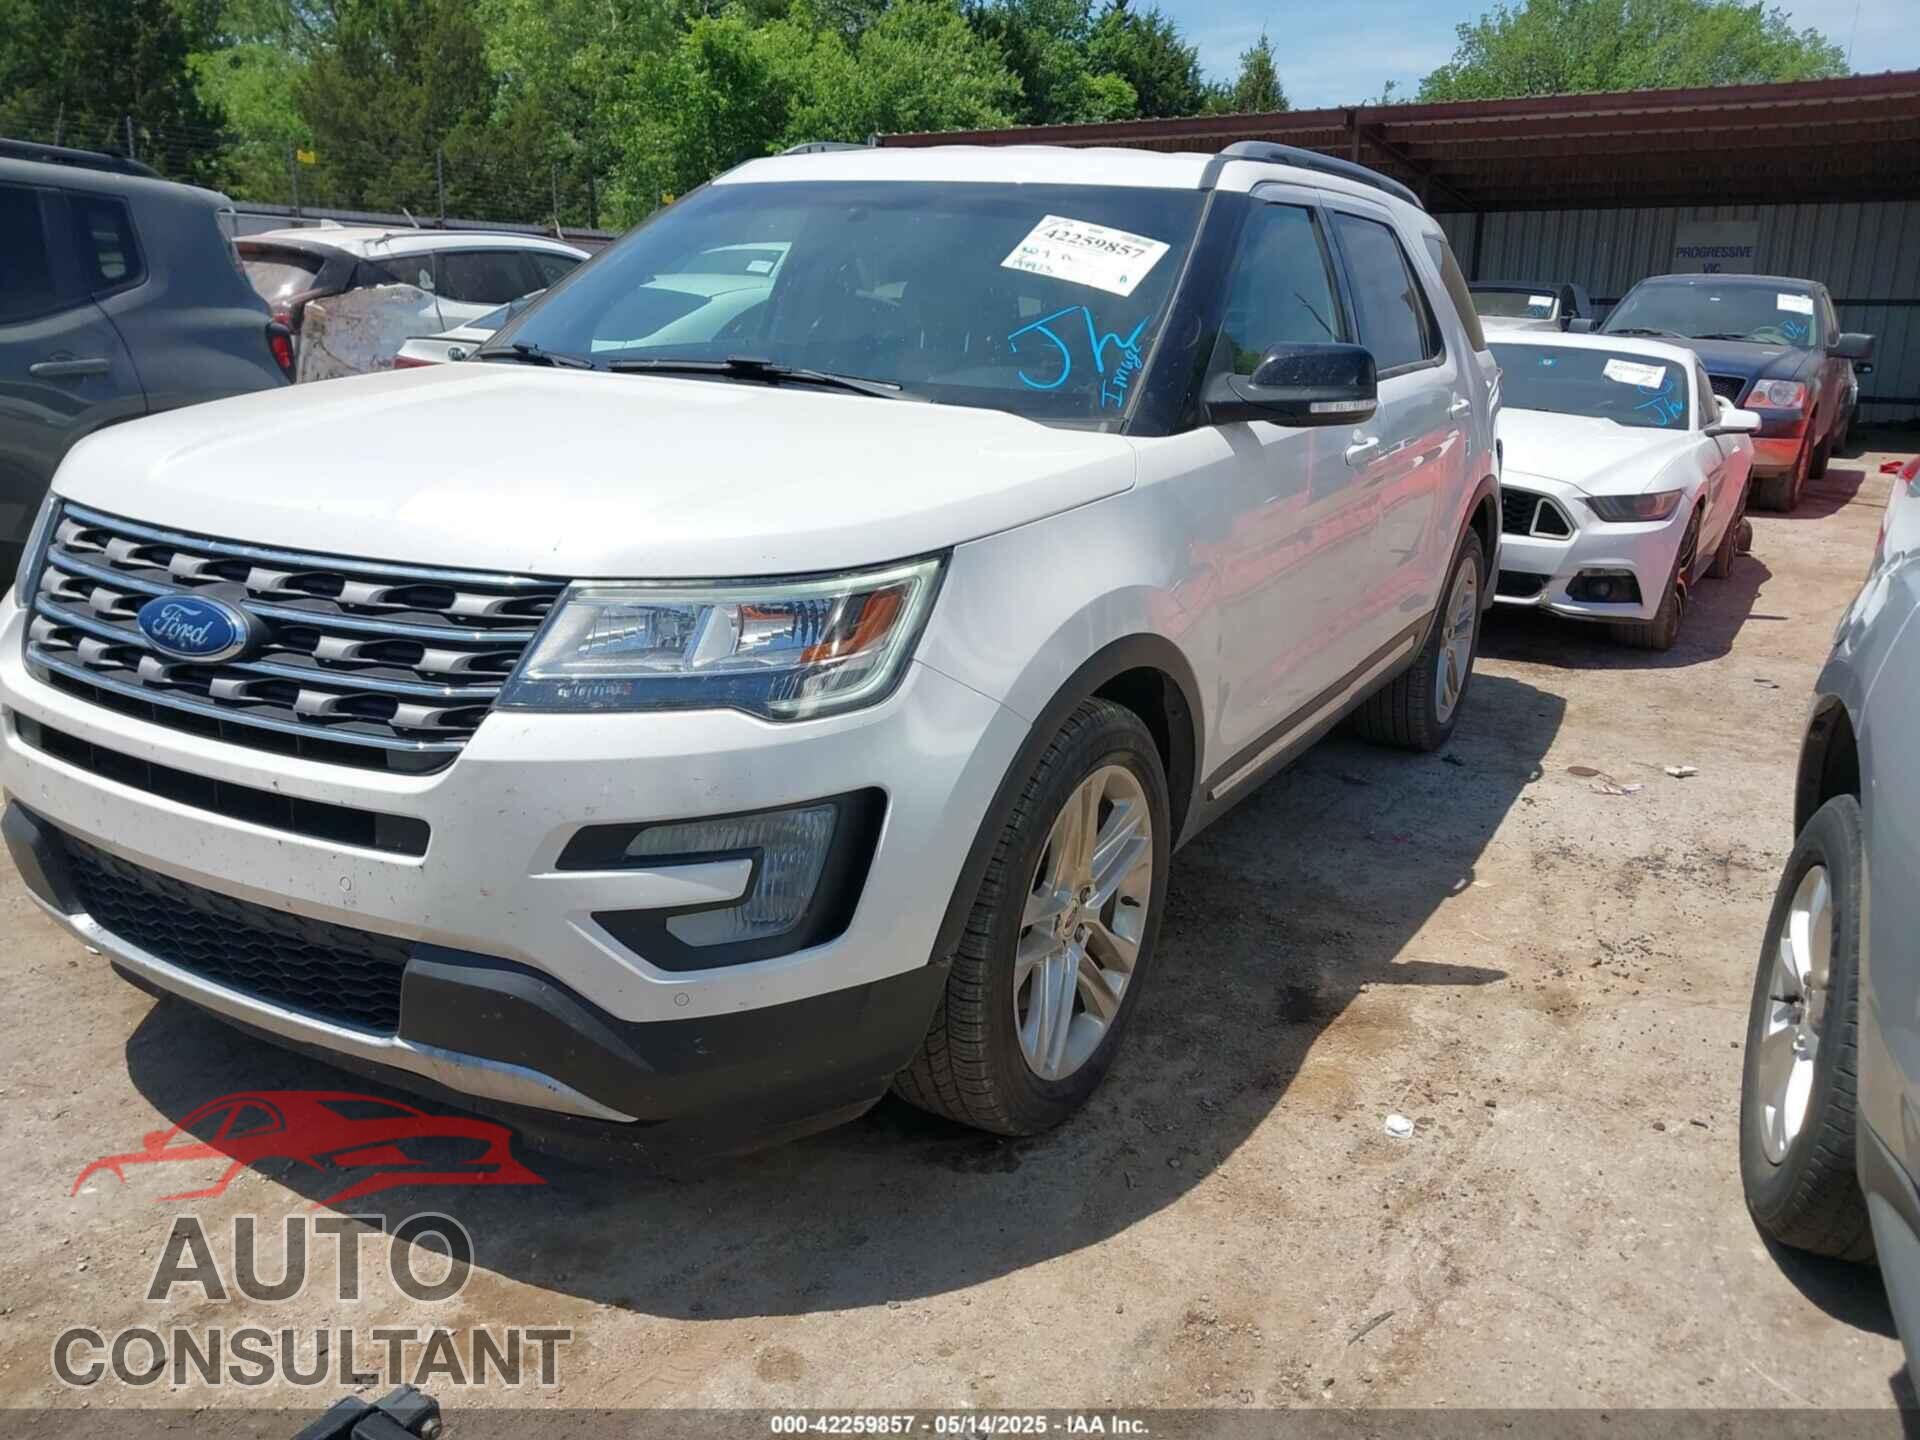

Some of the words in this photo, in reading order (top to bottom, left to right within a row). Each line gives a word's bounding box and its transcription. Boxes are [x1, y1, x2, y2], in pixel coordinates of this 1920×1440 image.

[1044, 229, 1145, 259] 42259857
[1676, 245, 1753, 258] PROGRESSIVE
[152, 603, 214, 645] Ford
